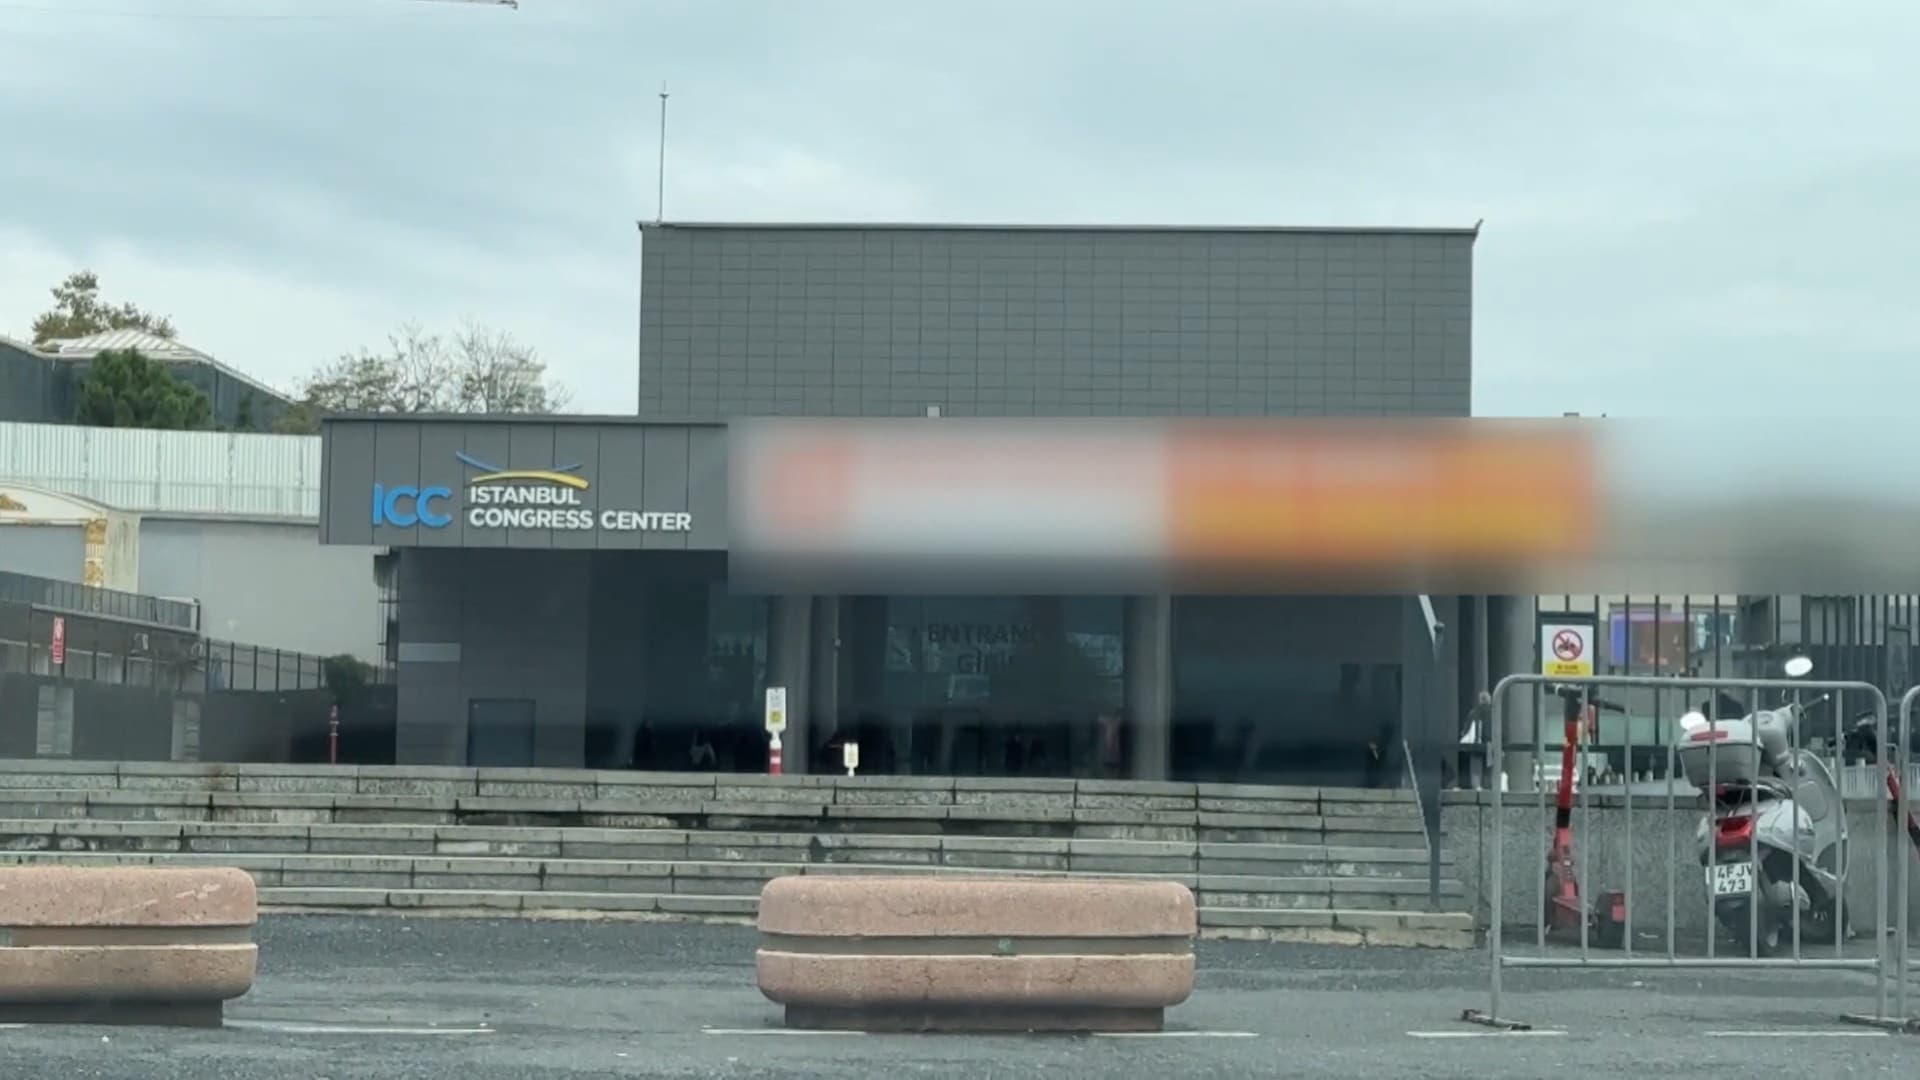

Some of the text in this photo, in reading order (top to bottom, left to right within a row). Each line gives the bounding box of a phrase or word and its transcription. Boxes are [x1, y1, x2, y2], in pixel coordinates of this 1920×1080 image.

[372, 483, 452, 528] ICC
[470, 486, 581, 505] ISTANBUL
[469, 508, 692, 531] CONGRESS CENTER
[928, 623, 1040, 645] ENTRAN
